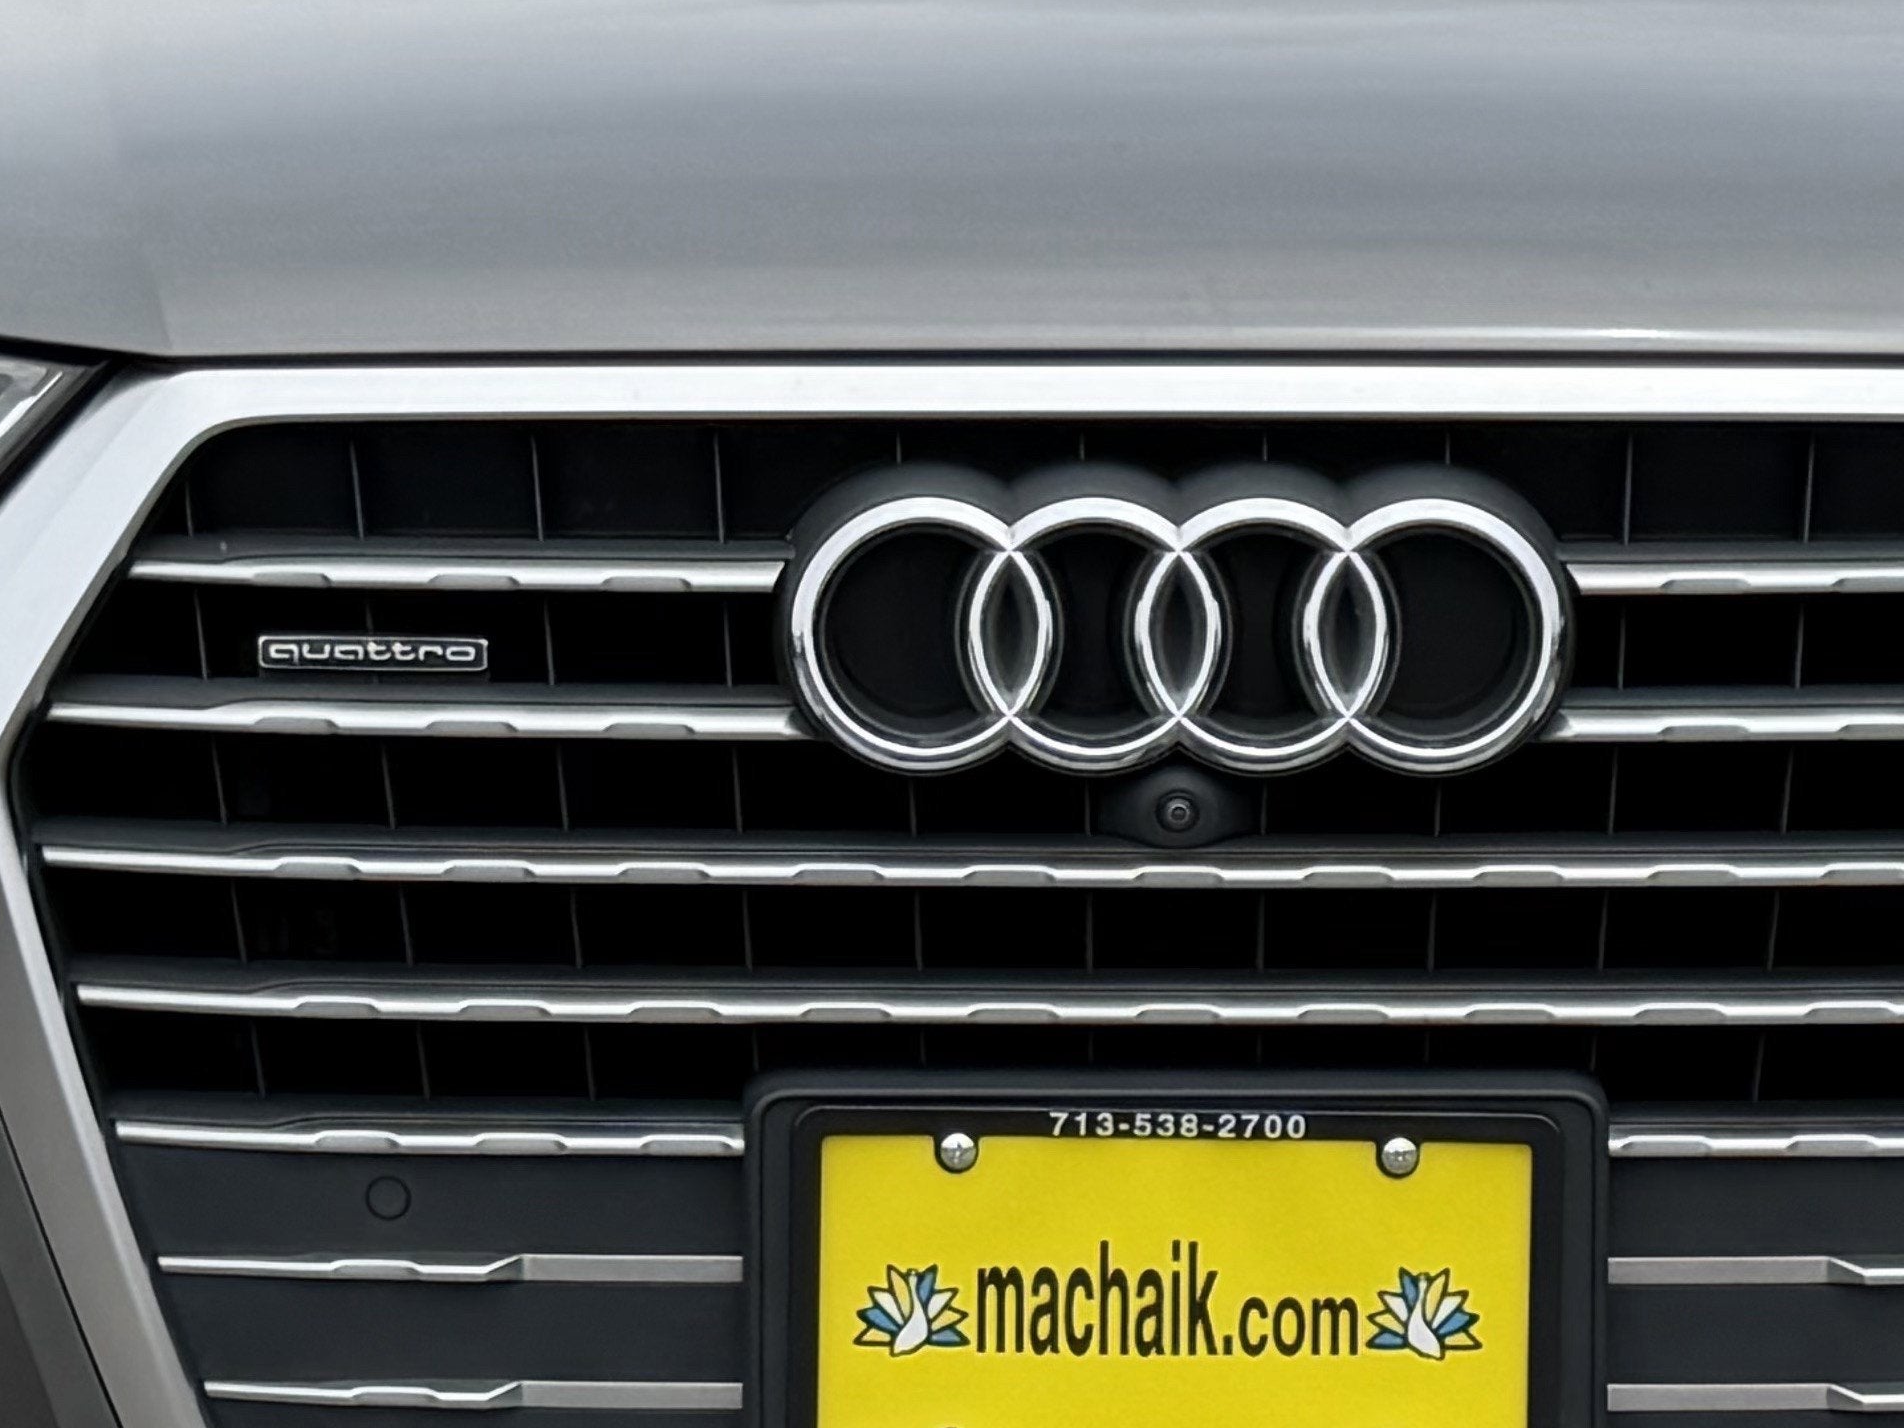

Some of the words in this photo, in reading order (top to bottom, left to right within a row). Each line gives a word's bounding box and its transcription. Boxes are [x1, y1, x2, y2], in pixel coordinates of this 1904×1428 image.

[268, 642, 476, 663] quattro
[1049, 1113, 1307, 1139] 713-538-2700
[974, 1239, 1360, 1357] machaik.com
